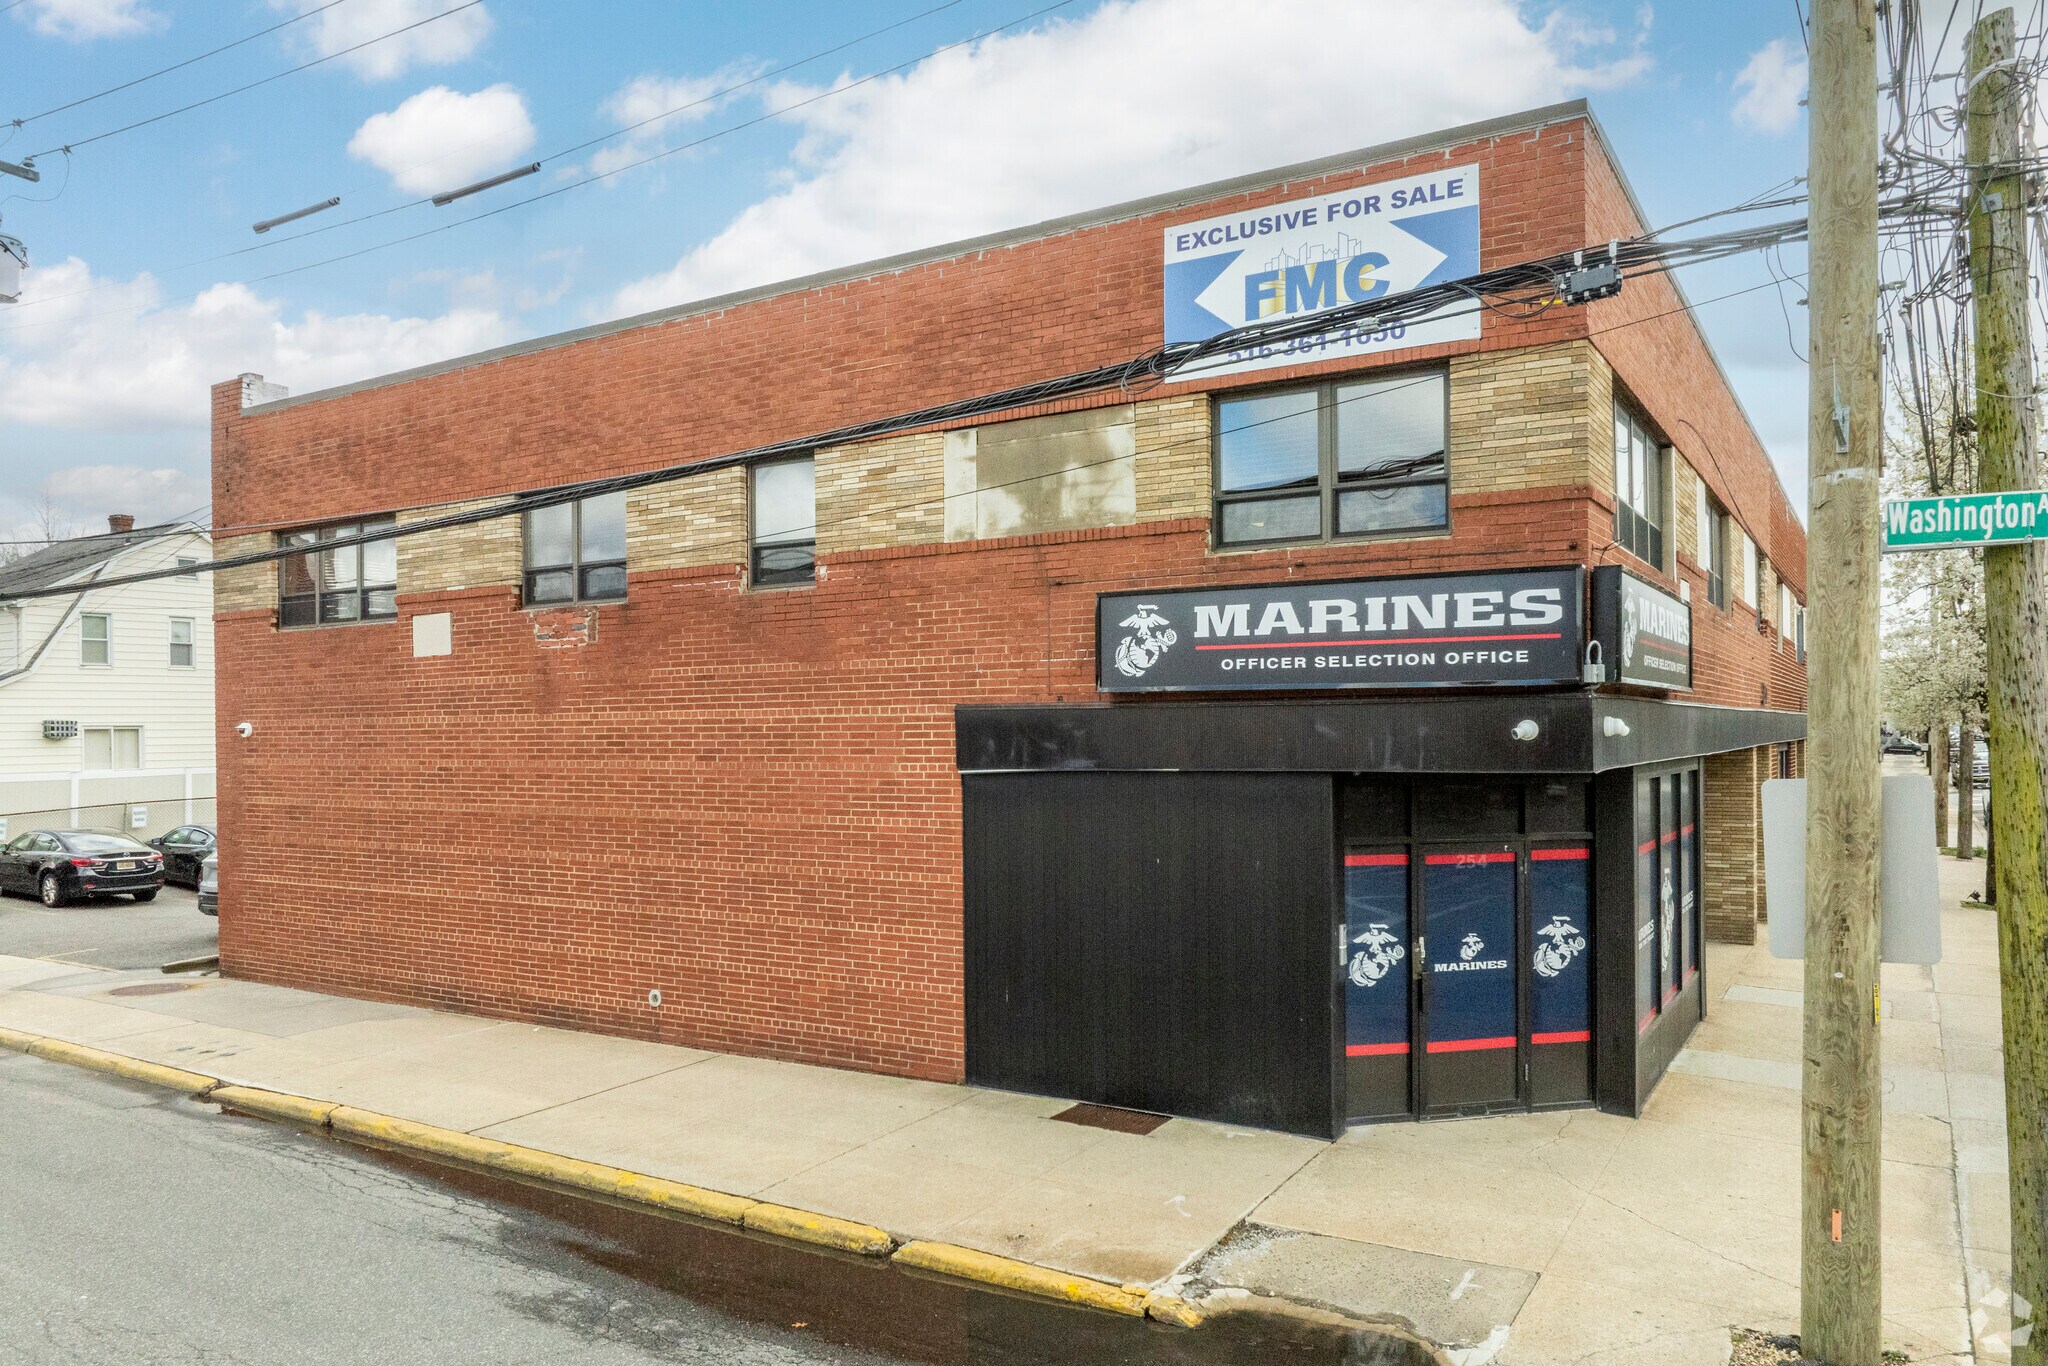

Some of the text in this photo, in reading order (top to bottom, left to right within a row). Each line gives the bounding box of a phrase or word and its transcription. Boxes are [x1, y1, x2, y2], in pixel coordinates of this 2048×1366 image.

[1176, 178, 1464, 253] EXCLUSIVE FOR SALE
[1245, 252, 1391, 322] FMC
[1888, 496, 2036, 540] Washington
[1194, 588, 1563, 638] MARINES
[1639, 597, 1689, 647] MARINES
[1221, 650, 1529, 671] OFFICER SELECTION OFFICE
[1456, 854, 1488, 868] 254
[1434, 960, 1508, 973] MARINES
